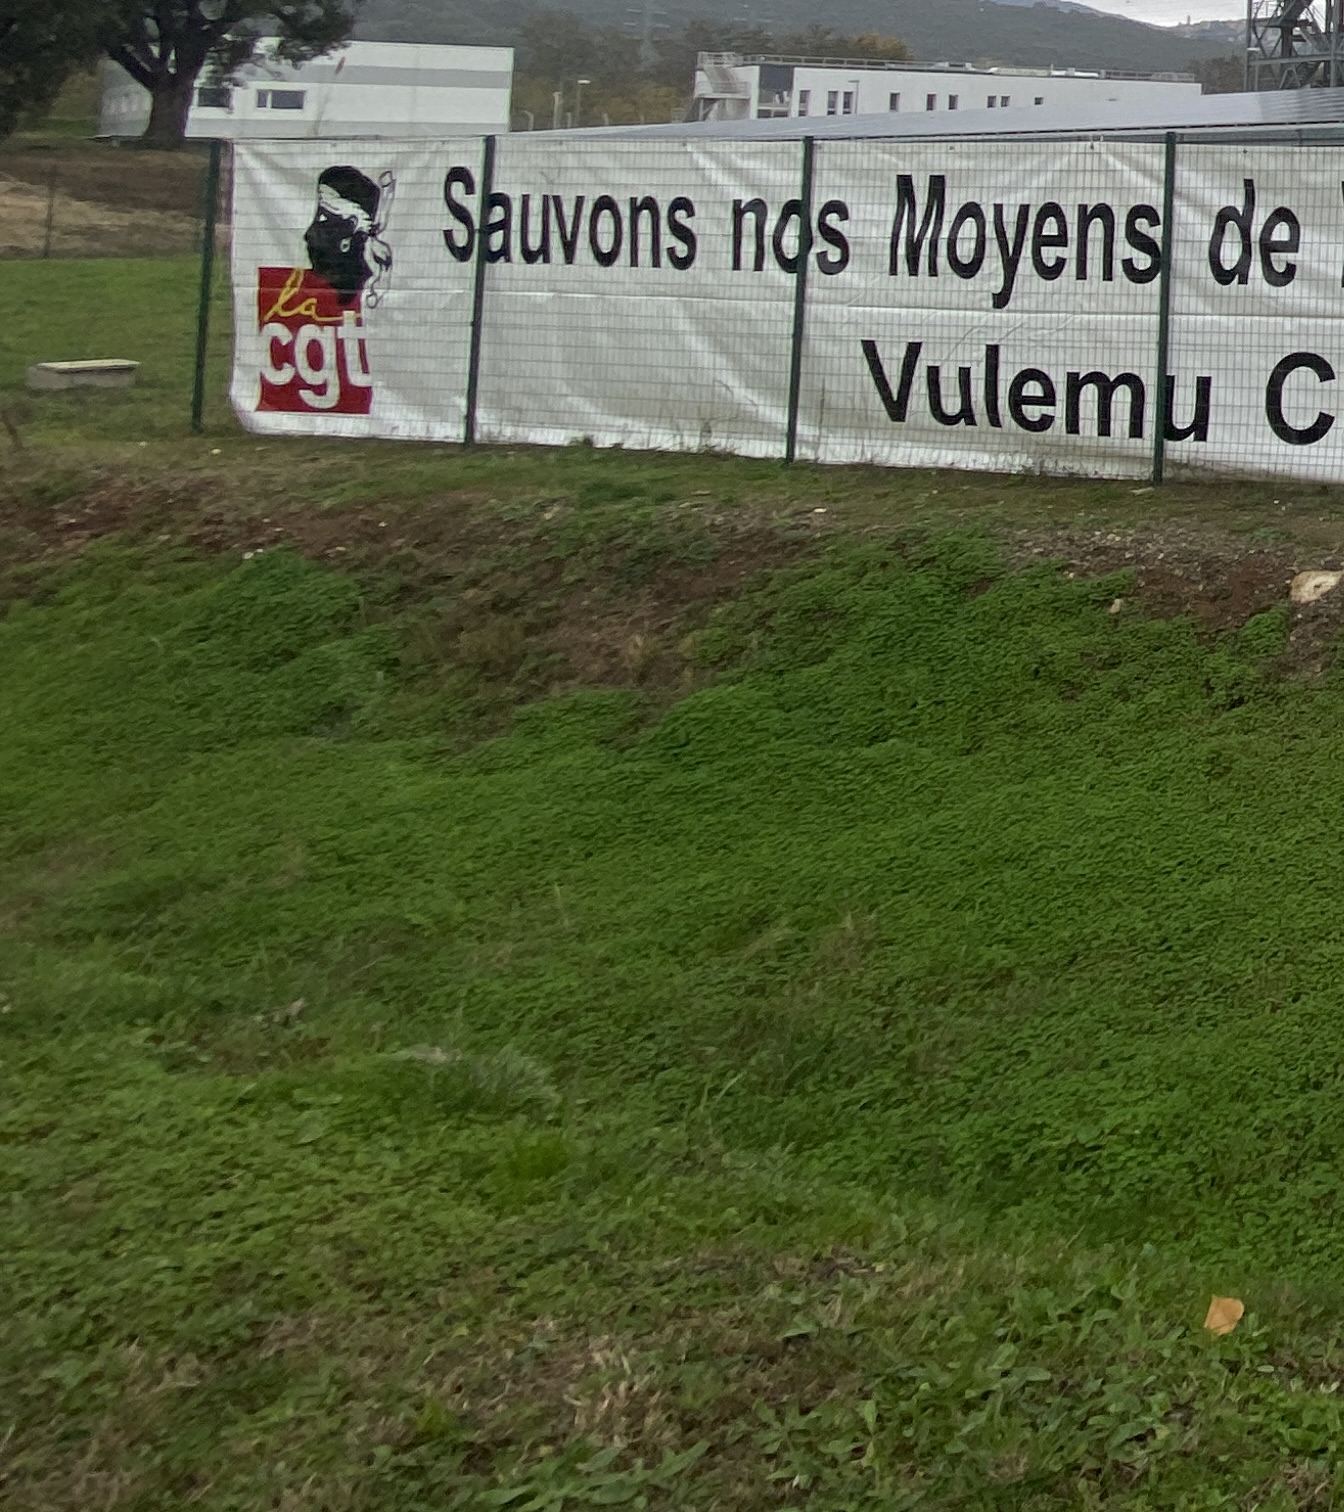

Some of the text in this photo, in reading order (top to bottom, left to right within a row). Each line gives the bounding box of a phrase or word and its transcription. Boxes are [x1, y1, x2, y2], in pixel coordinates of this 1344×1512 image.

[442, 165, 698, 271] Sauvons
[731, 197, 850, 277] nos
[888, 173, 1163, 309] Moyens
[1209, 178, 1301, 287] de
[860, 339, 1212, 442] Vulemu
